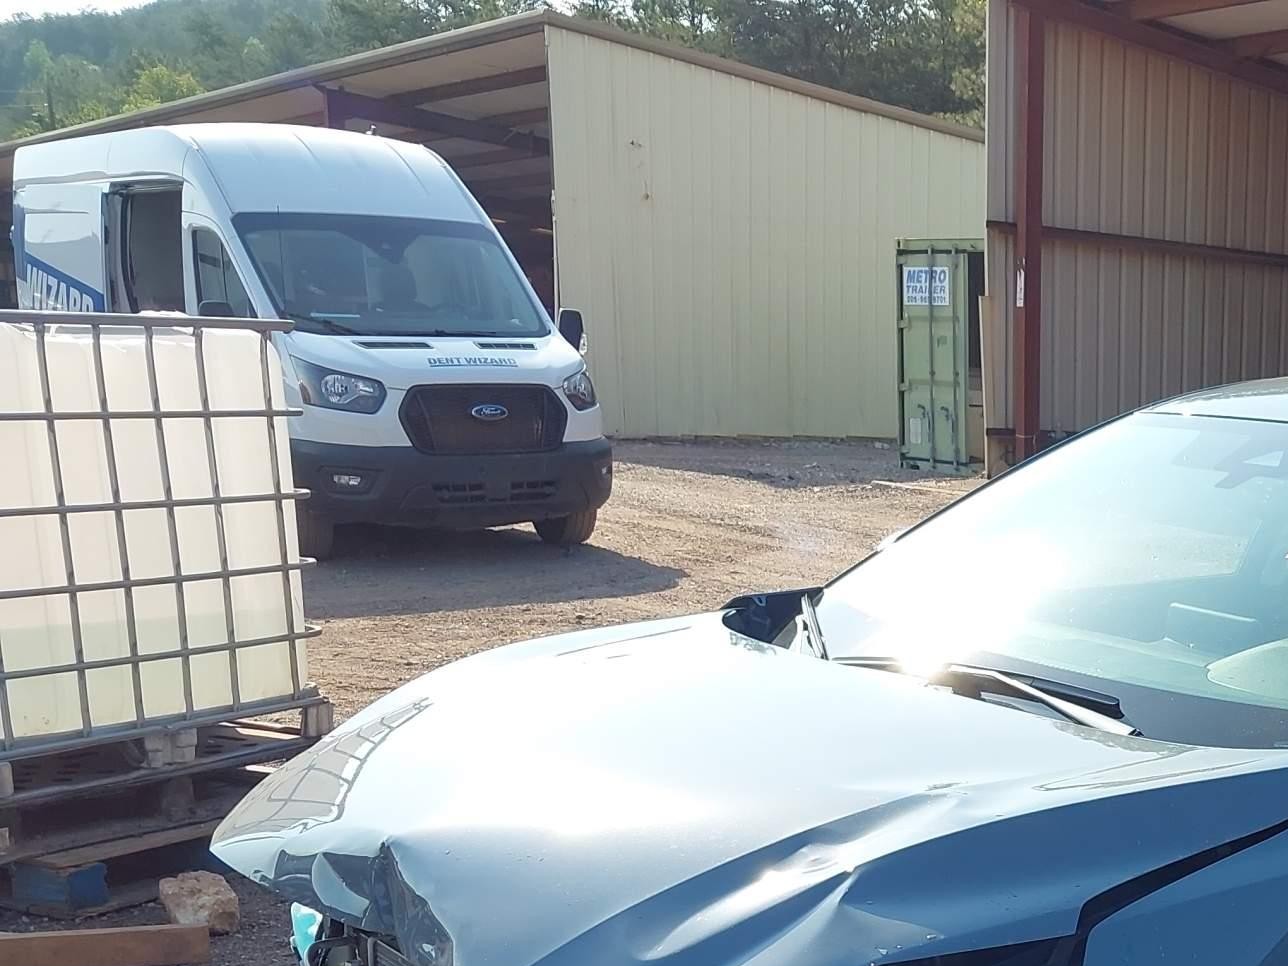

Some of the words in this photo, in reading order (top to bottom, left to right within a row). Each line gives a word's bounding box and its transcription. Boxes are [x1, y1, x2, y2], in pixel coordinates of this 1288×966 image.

[906, 269, 947, 284] METRO
[906, 285, 946, 295] TRAIER
[427, 357, 462, 365] DENT
[463, 357, 517, 365] WIZARD
